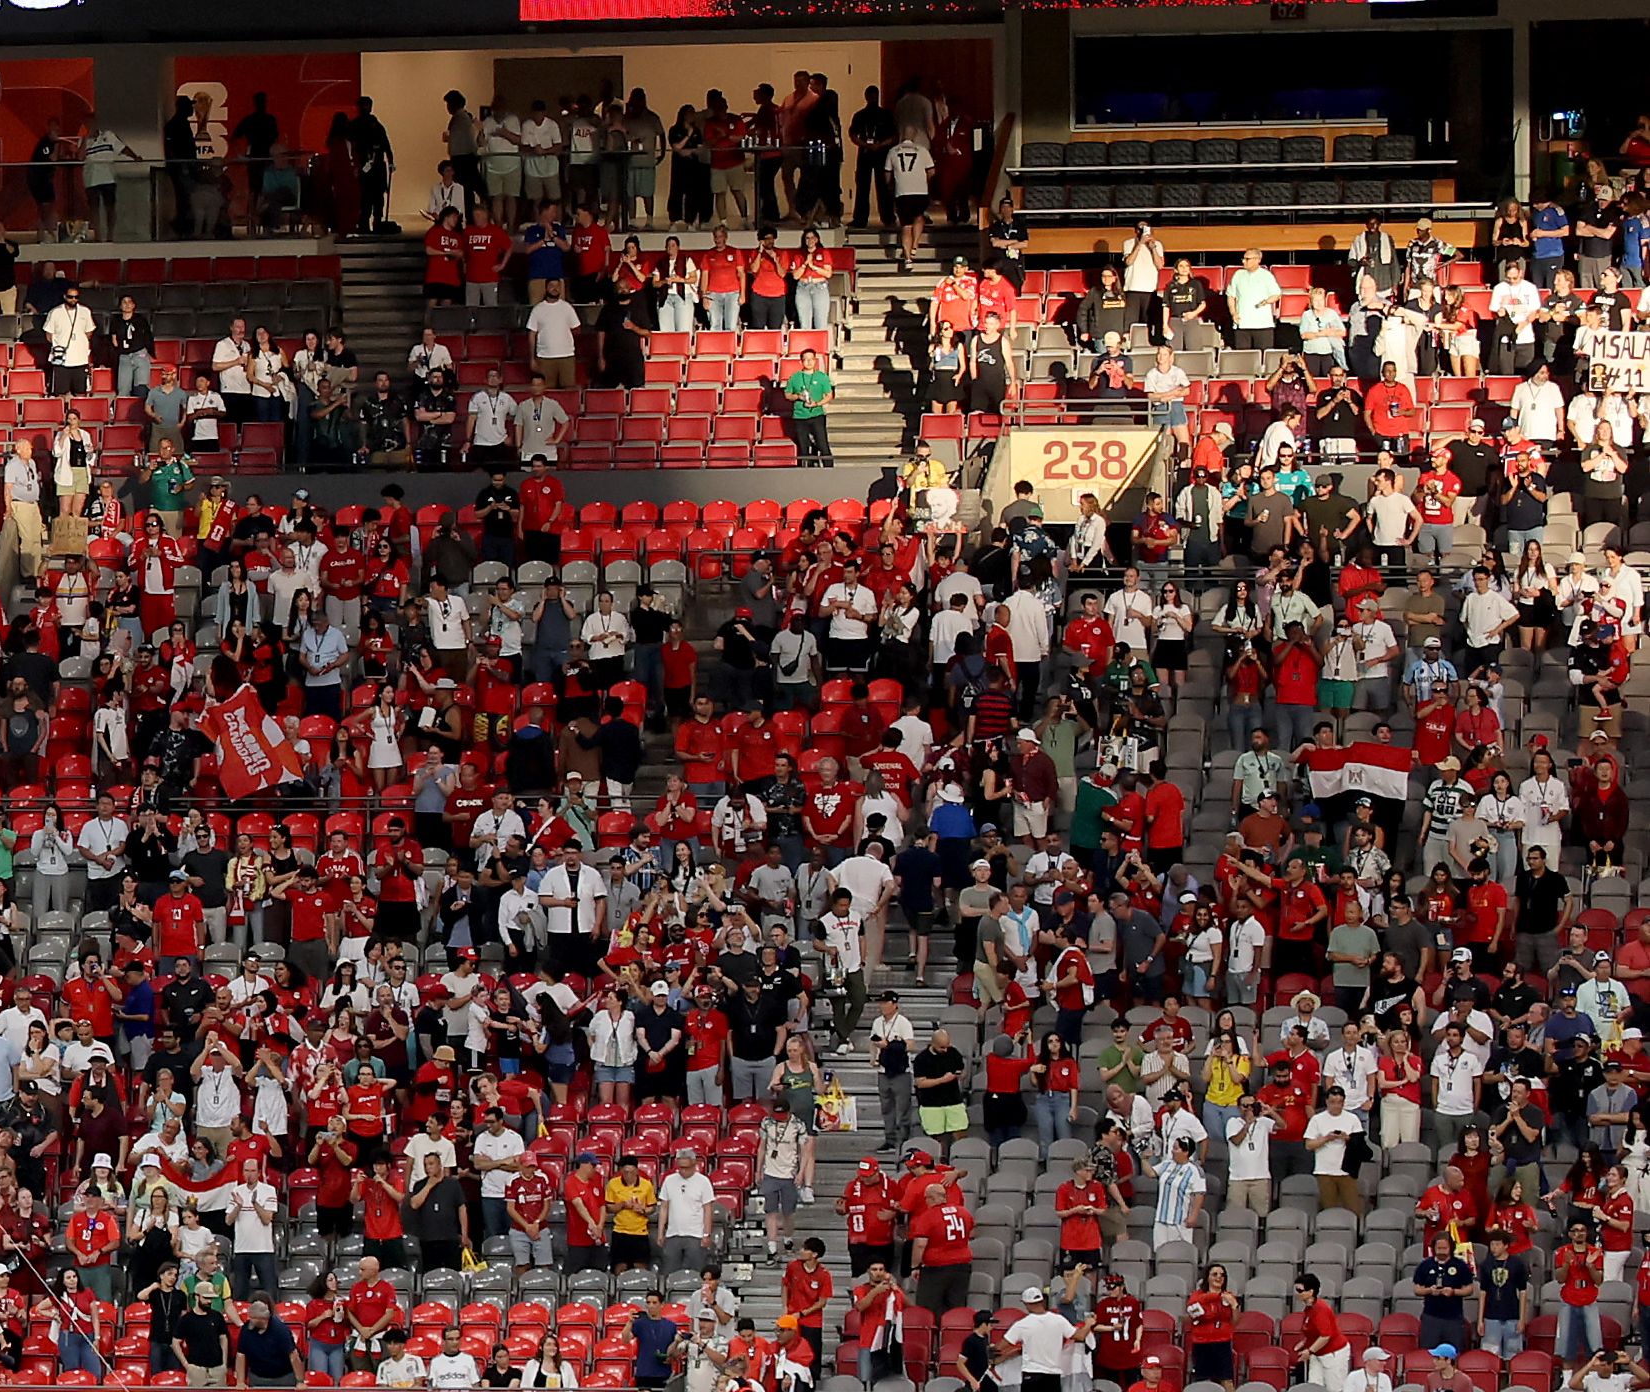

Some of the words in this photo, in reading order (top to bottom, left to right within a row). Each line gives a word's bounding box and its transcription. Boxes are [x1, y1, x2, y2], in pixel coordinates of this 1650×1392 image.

[896, 151, 918, 173] 17
[468, 235, 492, 245] EGYPT
[1042, 440, 1129, 480] 238
[224, 712, 257, 770] CANADA
[943, 1214, 966, 1242] 24
[439, 1372, 466, 1381] adidas
